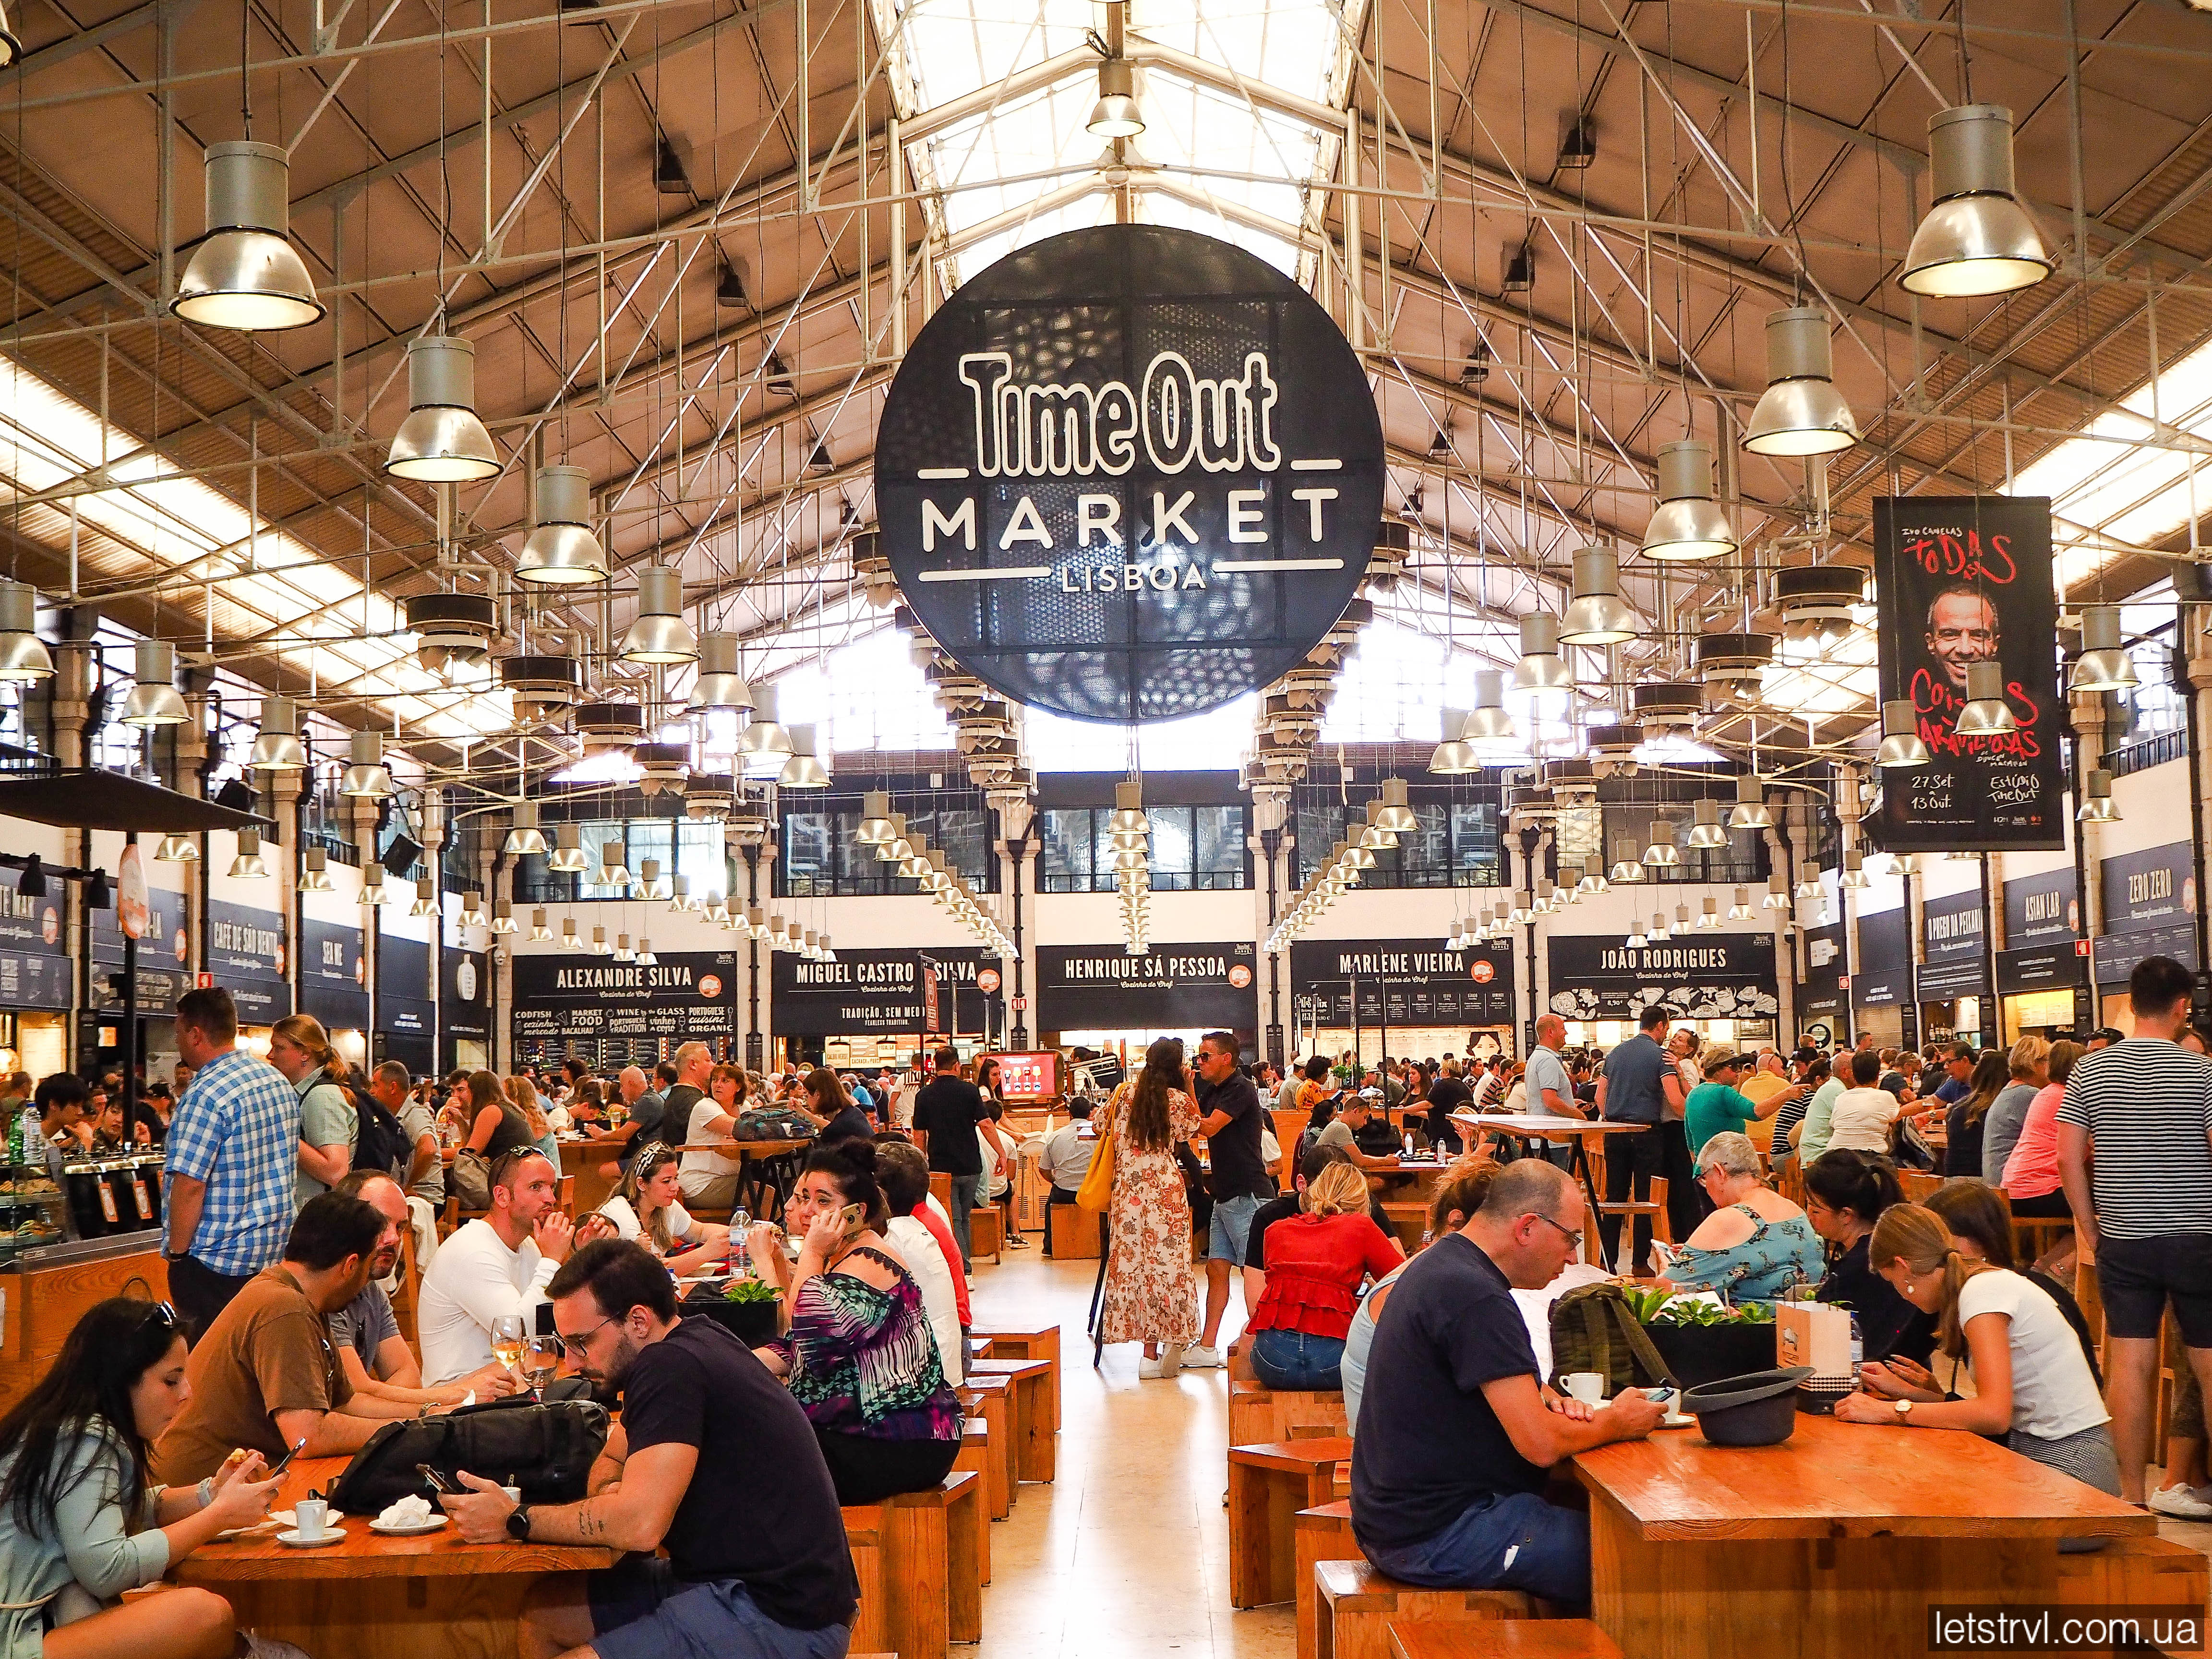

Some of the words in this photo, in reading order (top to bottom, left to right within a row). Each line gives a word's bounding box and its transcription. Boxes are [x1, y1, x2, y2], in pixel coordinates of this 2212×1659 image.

[959, 352, 1138, 477] Time
[1142, 350, 1281, 474] Out
[921, 488, 1338, 552] MARKET
[1062, 563, 1206, 592] LISBOA
[1911, 776, 1929, 788] 27
[1930, 773, 1955, 789] Set.
[1911, 796, 1927, 809] 13
[2128, 873, 2149, 903] ZERO
[2151, 868, 2172, 900] ZERO
[2025, 893, 2045, 922] ASIAN
[2046, 891, 2060, 918] LAB
[1340, 953, 1408, 974] MARLENE
[1413, 953, 1464, 973] VIEIRA
[1601, 947, 1636, 969] JOÃO
[1644, 949, 1727, 968] RODRIGUES
[796, 963, 852, 984] MIGUEL
[857, 962, 914, 983] CASTRO
[1065, 958, 1138, 979] HENRIQUE
[1145, 955, 1164, 977] SÁ
[1170, 957, 1226, 977] PESSOA
[557, 967, 643, 988] ALEXANDRE
[649, 966, 692, 987] SILVA
[1412, 975, 1429, 984] Chef
[897, 985, 914, 994] Chef
[1157, 981, 1174, 989] Chef
[515, 1010, 552, 1019] CODFISH
[657, 1008, 685, 1016] GLASS
[688, 1007, 725, 1016] PORTUGUESE
[842, 1006, 882, 1019] TRADIÇÃO,
[886, 1007, 902, 1018] SEM
[572, 1016, 603, 1026] FOOD
[649, 1016, 676, 1025] vinhos
[688, 1016, 725, 1024] cuisine
[610, 1024, 647, 1033] TRADITION
